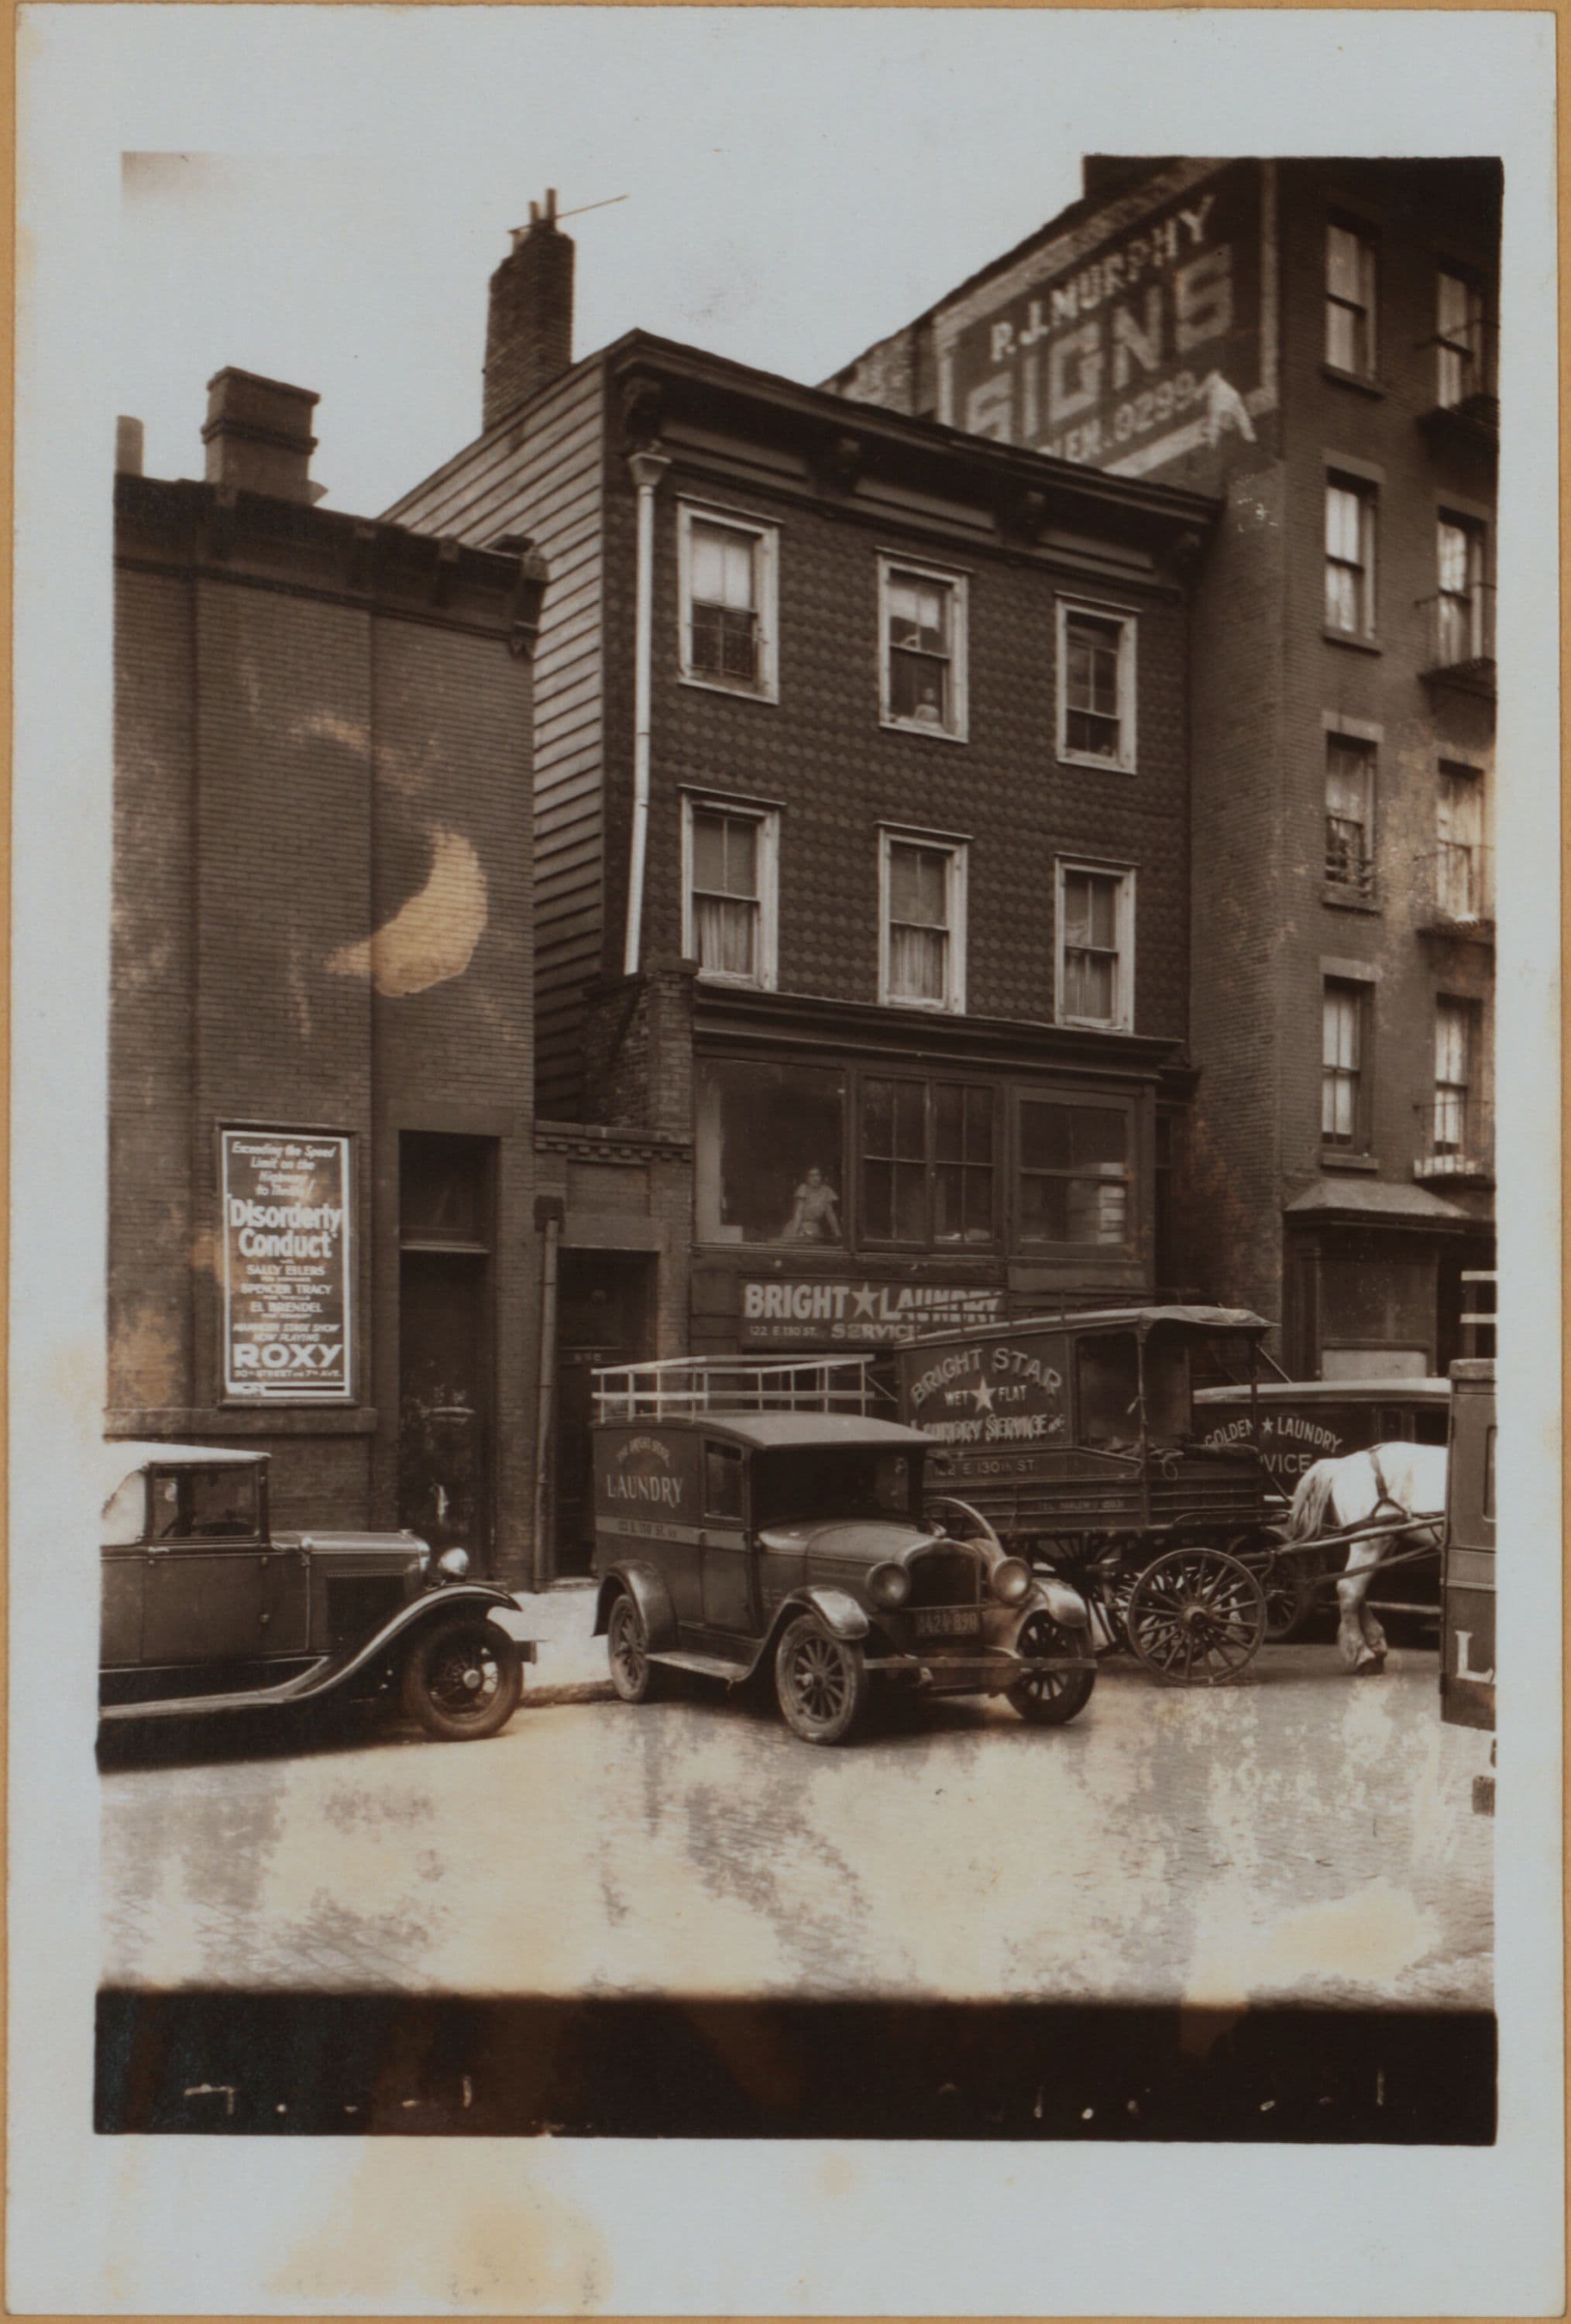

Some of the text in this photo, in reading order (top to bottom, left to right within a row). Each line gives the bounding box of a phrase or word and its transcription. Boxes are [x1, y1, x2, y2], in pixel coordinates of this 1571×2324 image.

[966, 244, 1234, 444] SIGNS
[246, 1265, 281, 1275] SALLY
[240, 1283, 332, 1295] SPENCER TRACY
[744, 1283, 1004, 1323] BRIGHT LAUNDRY
[233, 1343, 342, 1368] ROXY
[910, 1347, 1062, 1408] BRIGHT STAR
[998, 1385, 1028, 1402] FLAT
[985, 1413, 1047, 1442] SERVICE
[1277, 1416, 1344, 1454] LAUNDRY
[1260, 1454, 1312, 1474] VICE
[606, 1473, 683, 1509] LAUNDRY
